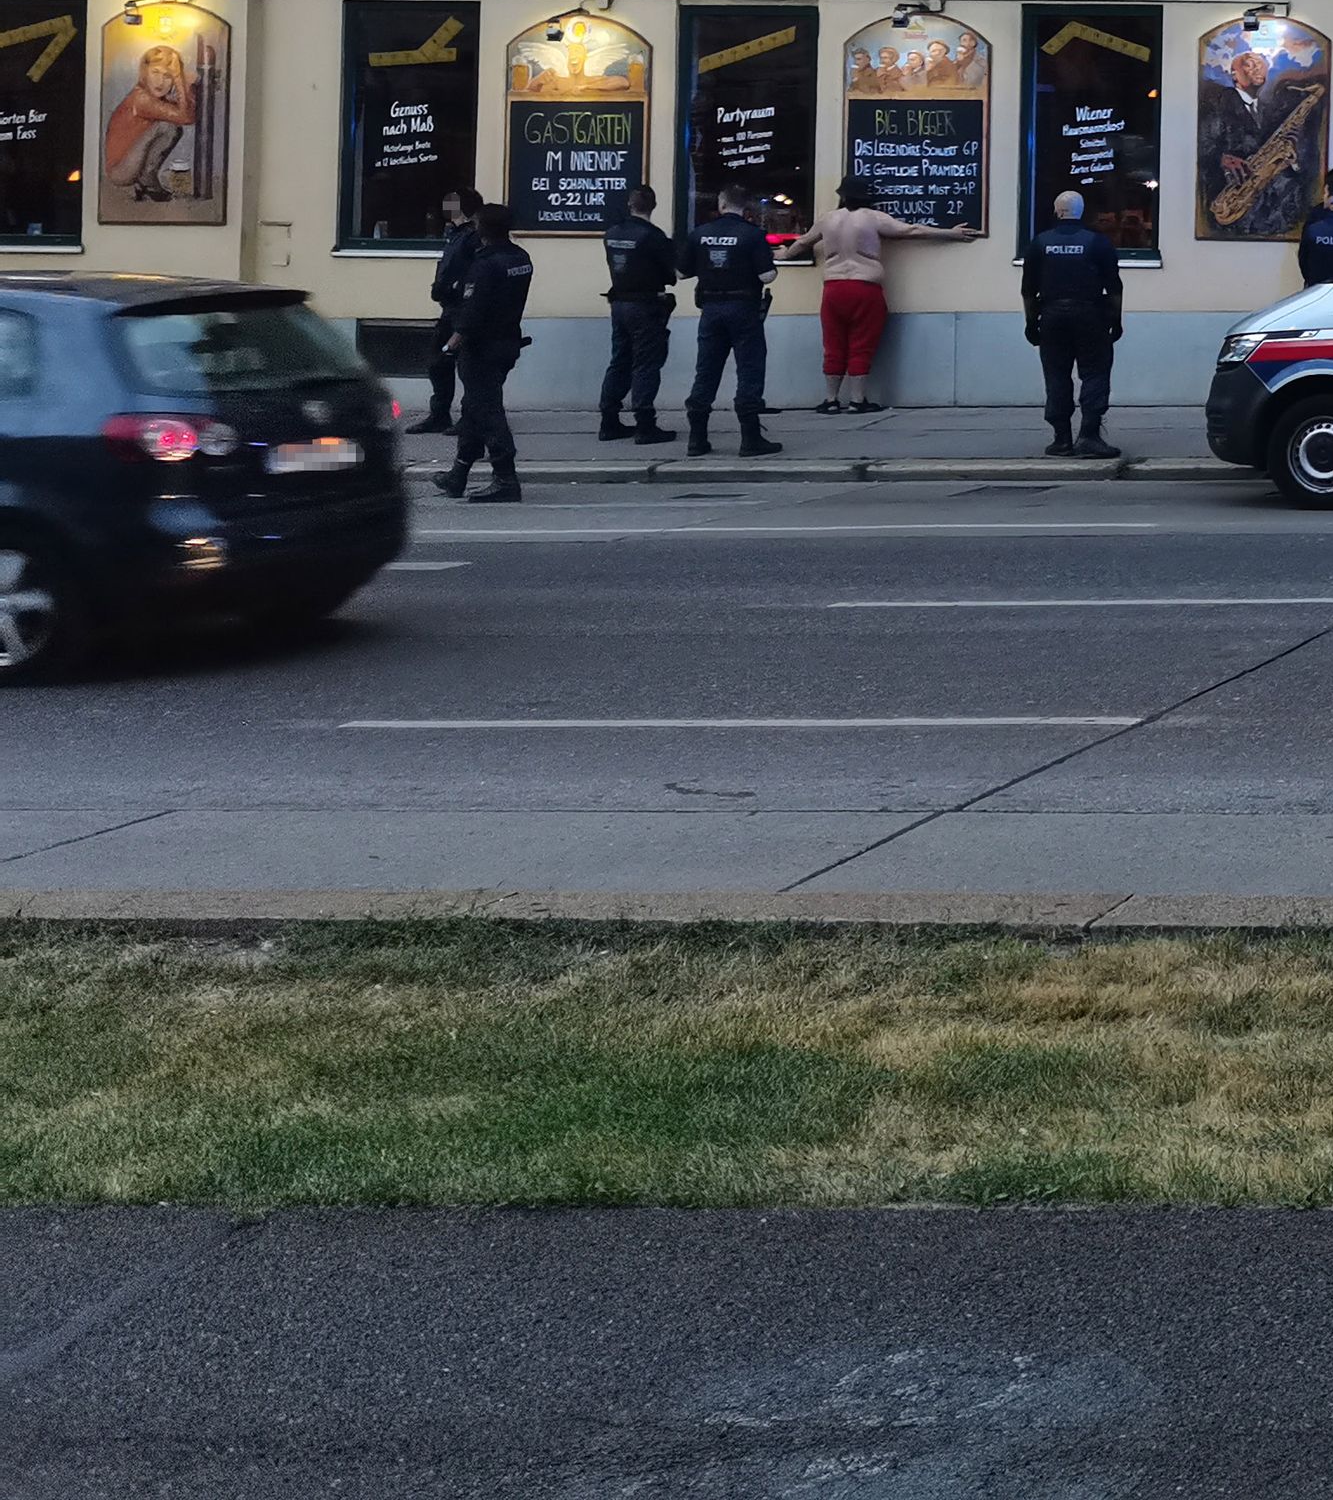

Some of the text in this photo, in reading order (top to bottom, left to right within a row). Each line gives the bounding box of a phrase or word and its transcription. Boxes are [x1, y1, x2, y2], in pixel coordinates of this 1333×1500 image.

[390, 101, 429, 118] Genuss
[717, 106, 775, 127] Partyraum
[1075, 105, 1113, 122] Wiener
[383, 115, 434, 136] nach Maß
[524, 112, 632, 145] GASTGARTEN
[907, 109, 957, 137] BIGGER
[17, 125, 37, 140] Fass
[854, 138, 873, 156] DAS
[545, 151, 628, 172] IM INNENHOF
[532, 178, 627, 191] BEI SCHÖNWETTER
[547, 192, 605, 206] 10-22 UHR
[903, 200, 937, 214] WURST
[700, 236, 738, 246] POLIZEI
[1045, 245, 1084, 255] POLIZEI
